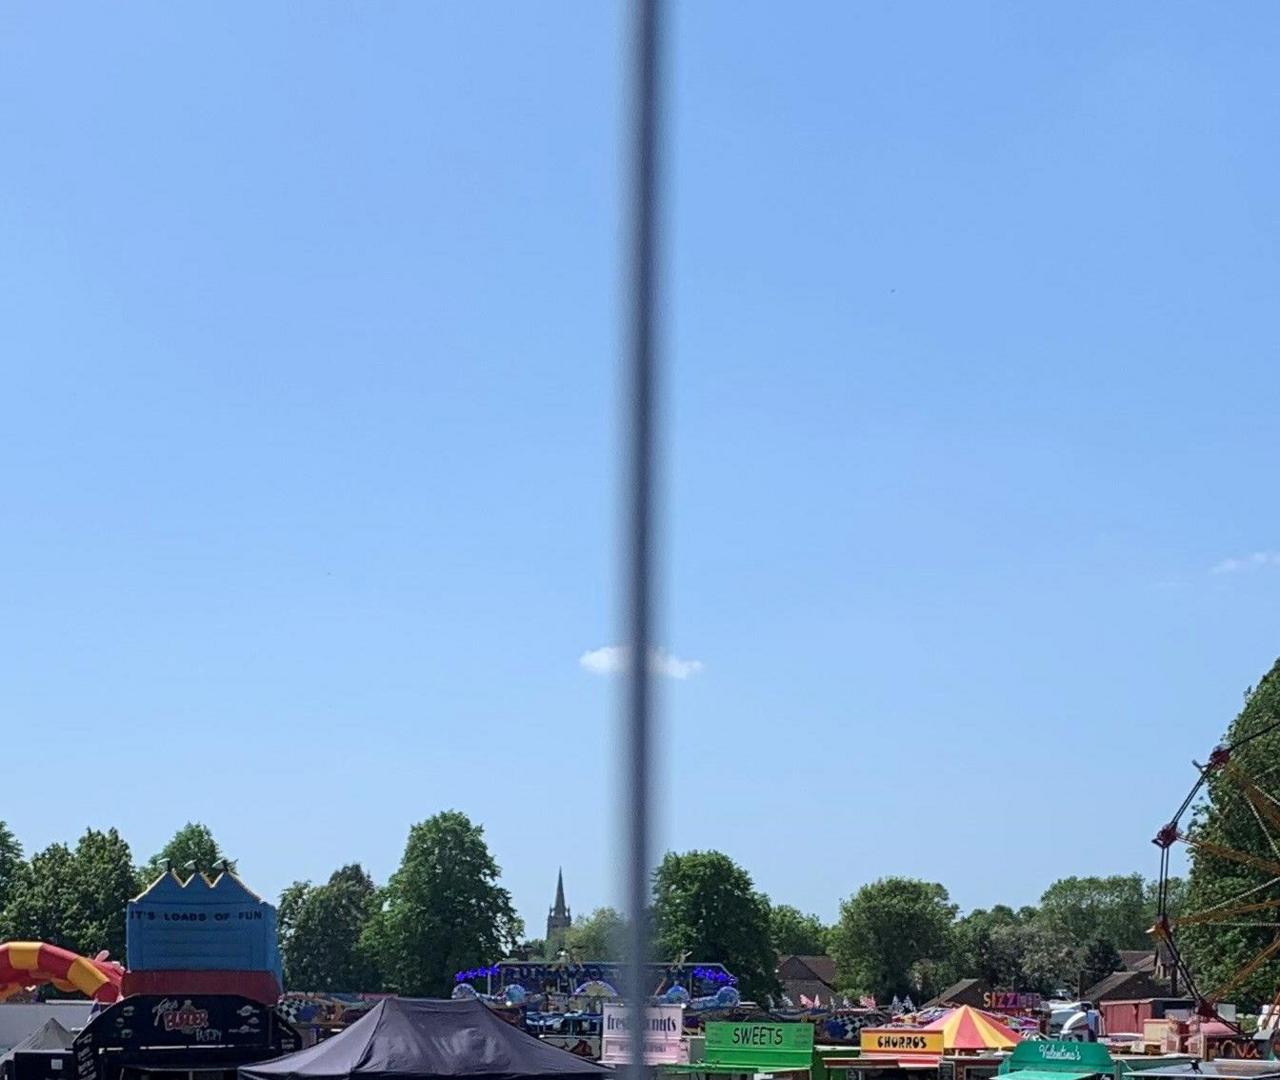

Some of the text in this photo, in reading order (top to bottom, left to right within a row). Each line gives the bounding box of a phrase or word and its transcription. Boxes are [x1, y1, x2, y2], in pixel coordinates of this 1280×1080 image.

[130, 910, 262, 922] IT'S LOADS OF FUN
[731, 1026, 783, 1045] SWEETS
